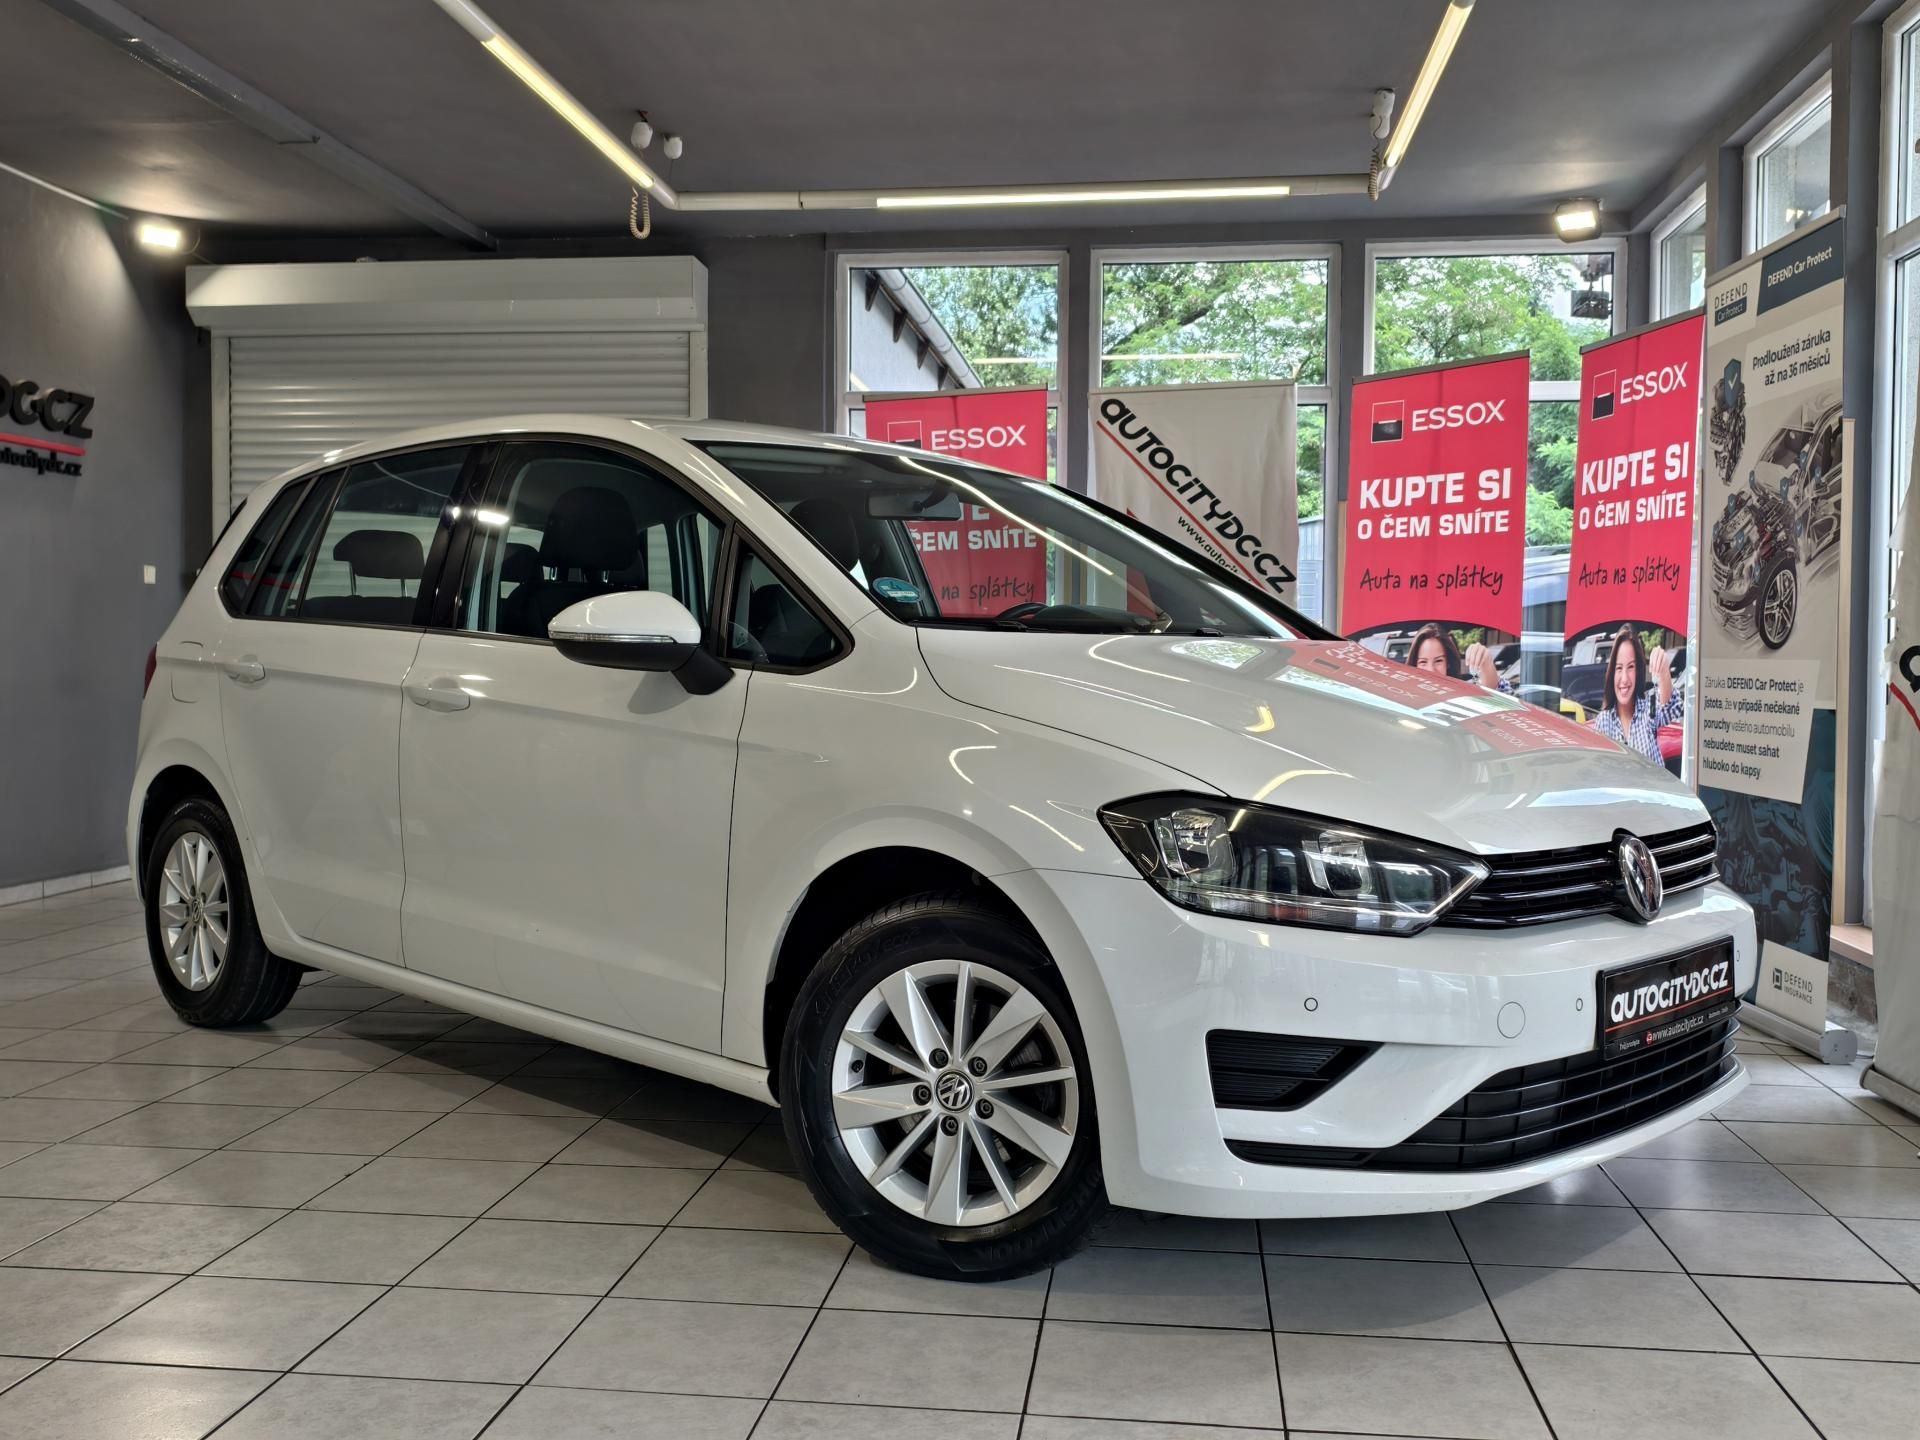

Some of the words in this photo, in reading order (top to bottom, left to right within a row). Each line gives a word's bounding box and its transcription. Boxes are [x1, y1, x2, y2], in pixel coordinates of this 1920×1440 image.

[1767, 267, 1793, 288] DEFEND
[1794, 260, 1805, 274] Car
[1806, 247, 1832, 269] Protect
[1714, 282, 1748, 309] DEFEND
[1752, 338, 1800, 370] Prodloužená
[1801, 330, 1831, 352] záruka
[1764, 370, 1776, 386] až
[1777, 369, 1788, 383] na
[1788, 362, 1798, 379] 36
[1799, 348, 1831, 376] měsíců
[1620, 362, 1688, 404] ESSOX
[1411, 400, 1506, 431] ESSOX
[931, 425, 1027, 451] ESSOX
[1581, 449, 1656, 496] KUPTE
[1664, 441, 1690, 481] SI
[1360, 472, 1465, 510] KUPTE
[1478, 468, 1511, 502] SI
[1357, 519, 1372, 540] O
[1380, 513, 1430, 538] ČEM
[1438, 508, 1510, 536] SNÍTE
[1579, 508, 1590, 530] O
[1594, 500, 1630, 528] ČEM
[1636, 490, 1687, 521] SNÍTE
[911, 528, 959, 552] ČEM
[968, 524, 1037, 550] SNÍTE
[1360, 568, 1401, 590] Auta
[1409, 573, 1428, 590] na
[1436, 565, 1504, 596] splátky
[1579, 562, 1608, 586] Auta
[1613, 566, 1626, 584] na
[1632, 556, 1681, 591] splátky
[941, 585, 960, 600] na
[968, 576, 1035, 607] splátky
[1704, 676, 1726, 689] Záruka
[1726, 677, 1754, 690] DEFEND
[1754, 678, 1767, 692] Car
[1769, 679, 1796, 693] Protect
[1724, 698, 1732, 710] že
[1738, 698, 1762, 715] případě
[1764, 702, 1800, 715] nečekané
[1704, 719, 1730, 734] poruchy
[1731, 720, 1752, 735] vašeho
[1753, 722, 1795, 738] automobilu
[1704, 738, 1735, 752] nebudete
[1736, 744, 1757, 756] muset
[1758, 745, 1780, 758] sahat
[1702, 757, 1730, 772] hluboko
[1731, 760, 1740, 773] do
[1740, 762, 1761, 780] kapsy
[1783, 985, 1813, 1004] INSURANCE
[1784, 971, 1813, 993] DEFEND
